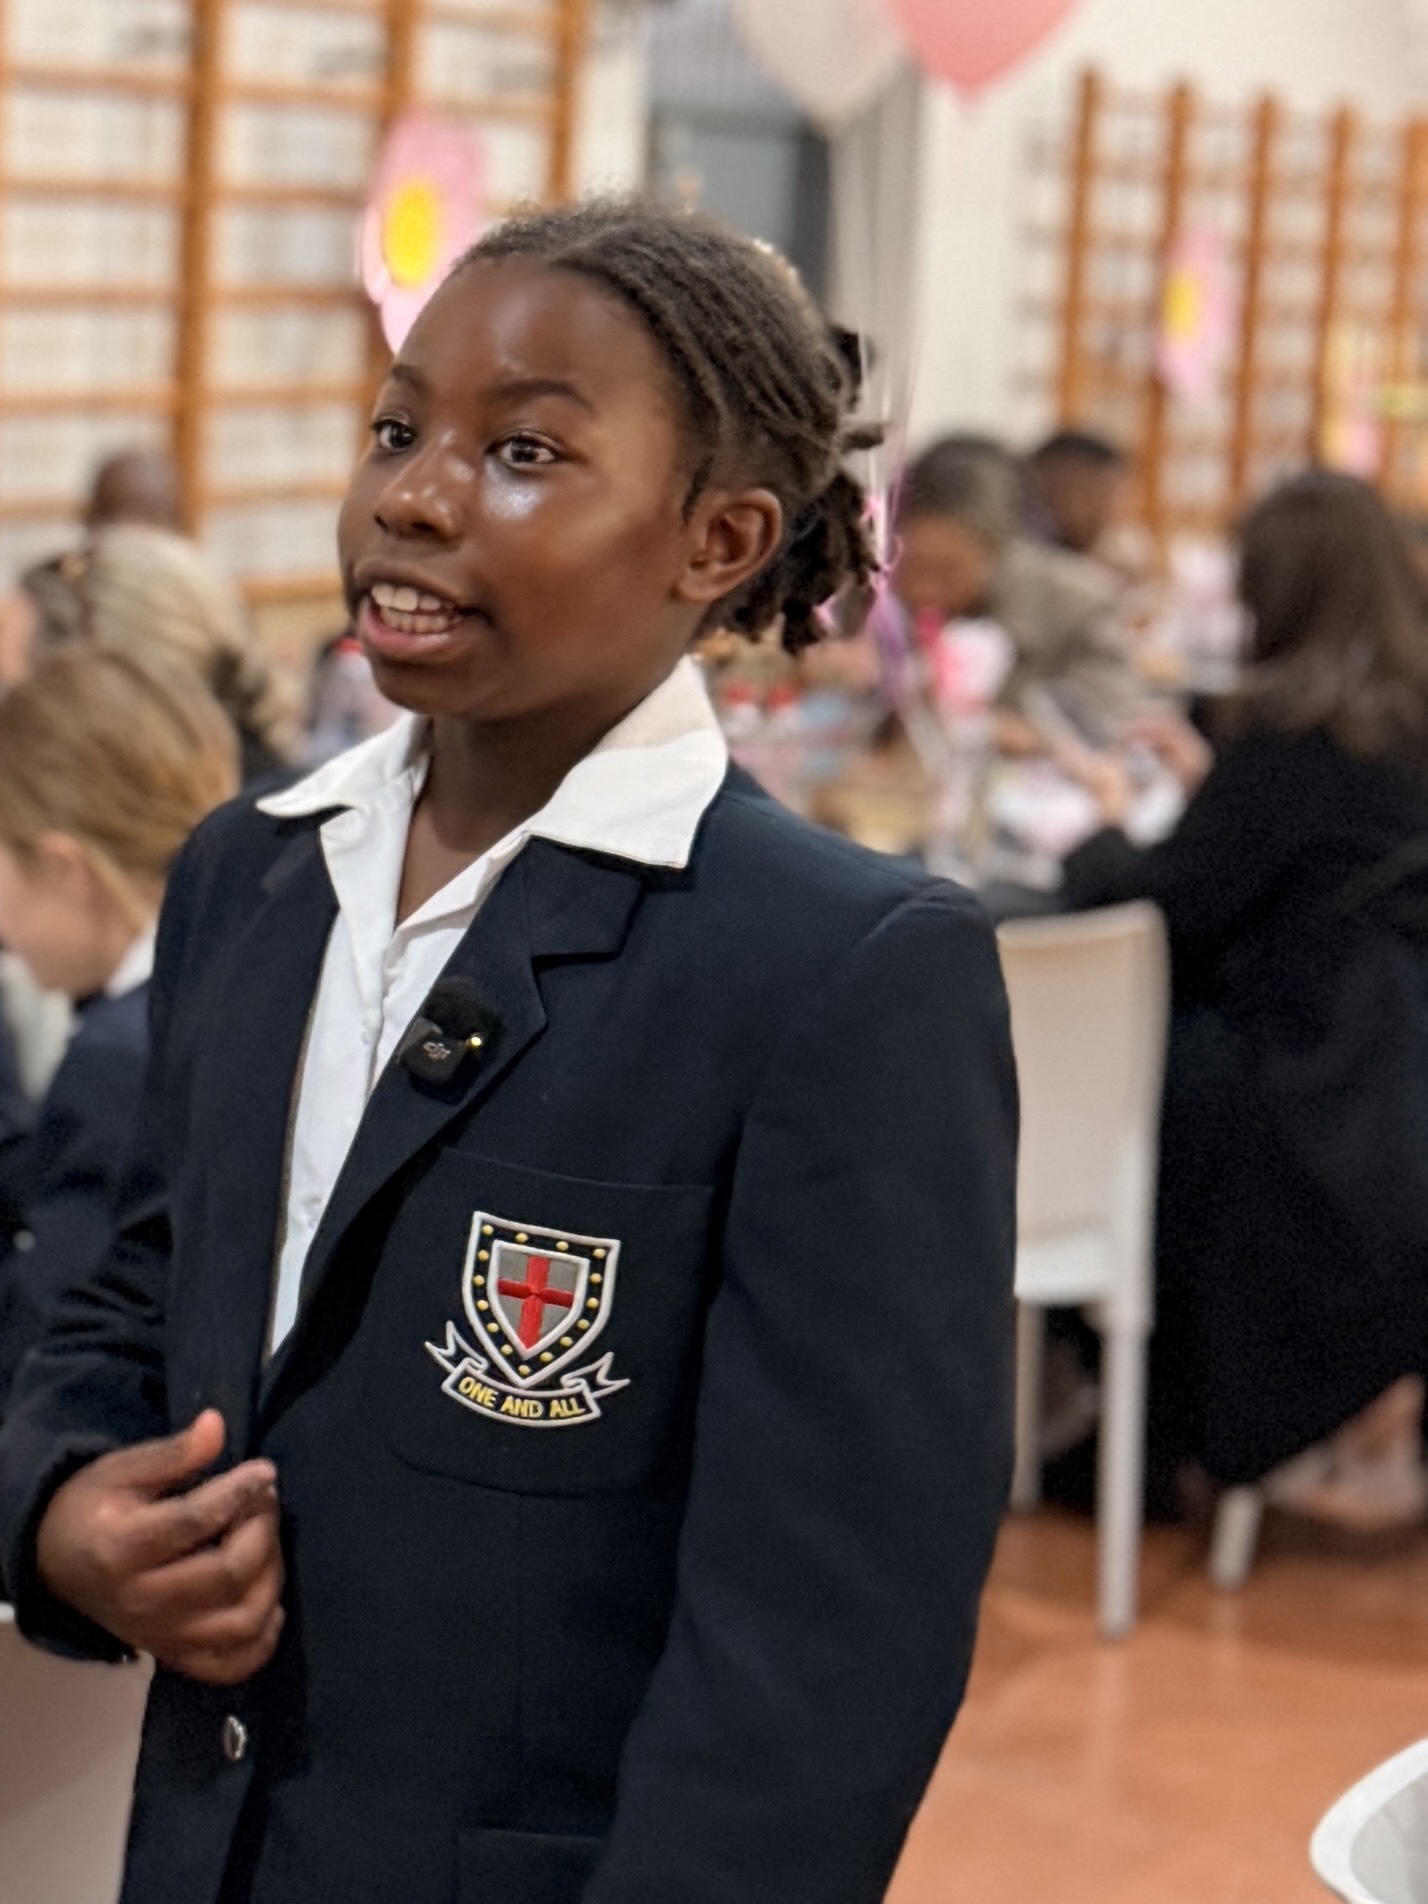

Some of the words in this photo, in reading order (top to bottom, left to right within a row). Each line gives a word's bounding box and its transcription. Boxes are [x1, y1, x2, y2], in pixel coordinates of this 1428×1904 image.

[458, 1376, 499, 1408] ONE
[500, 1395, 545, 1418] AND
[549, 1397, 586, 1418] ALL
